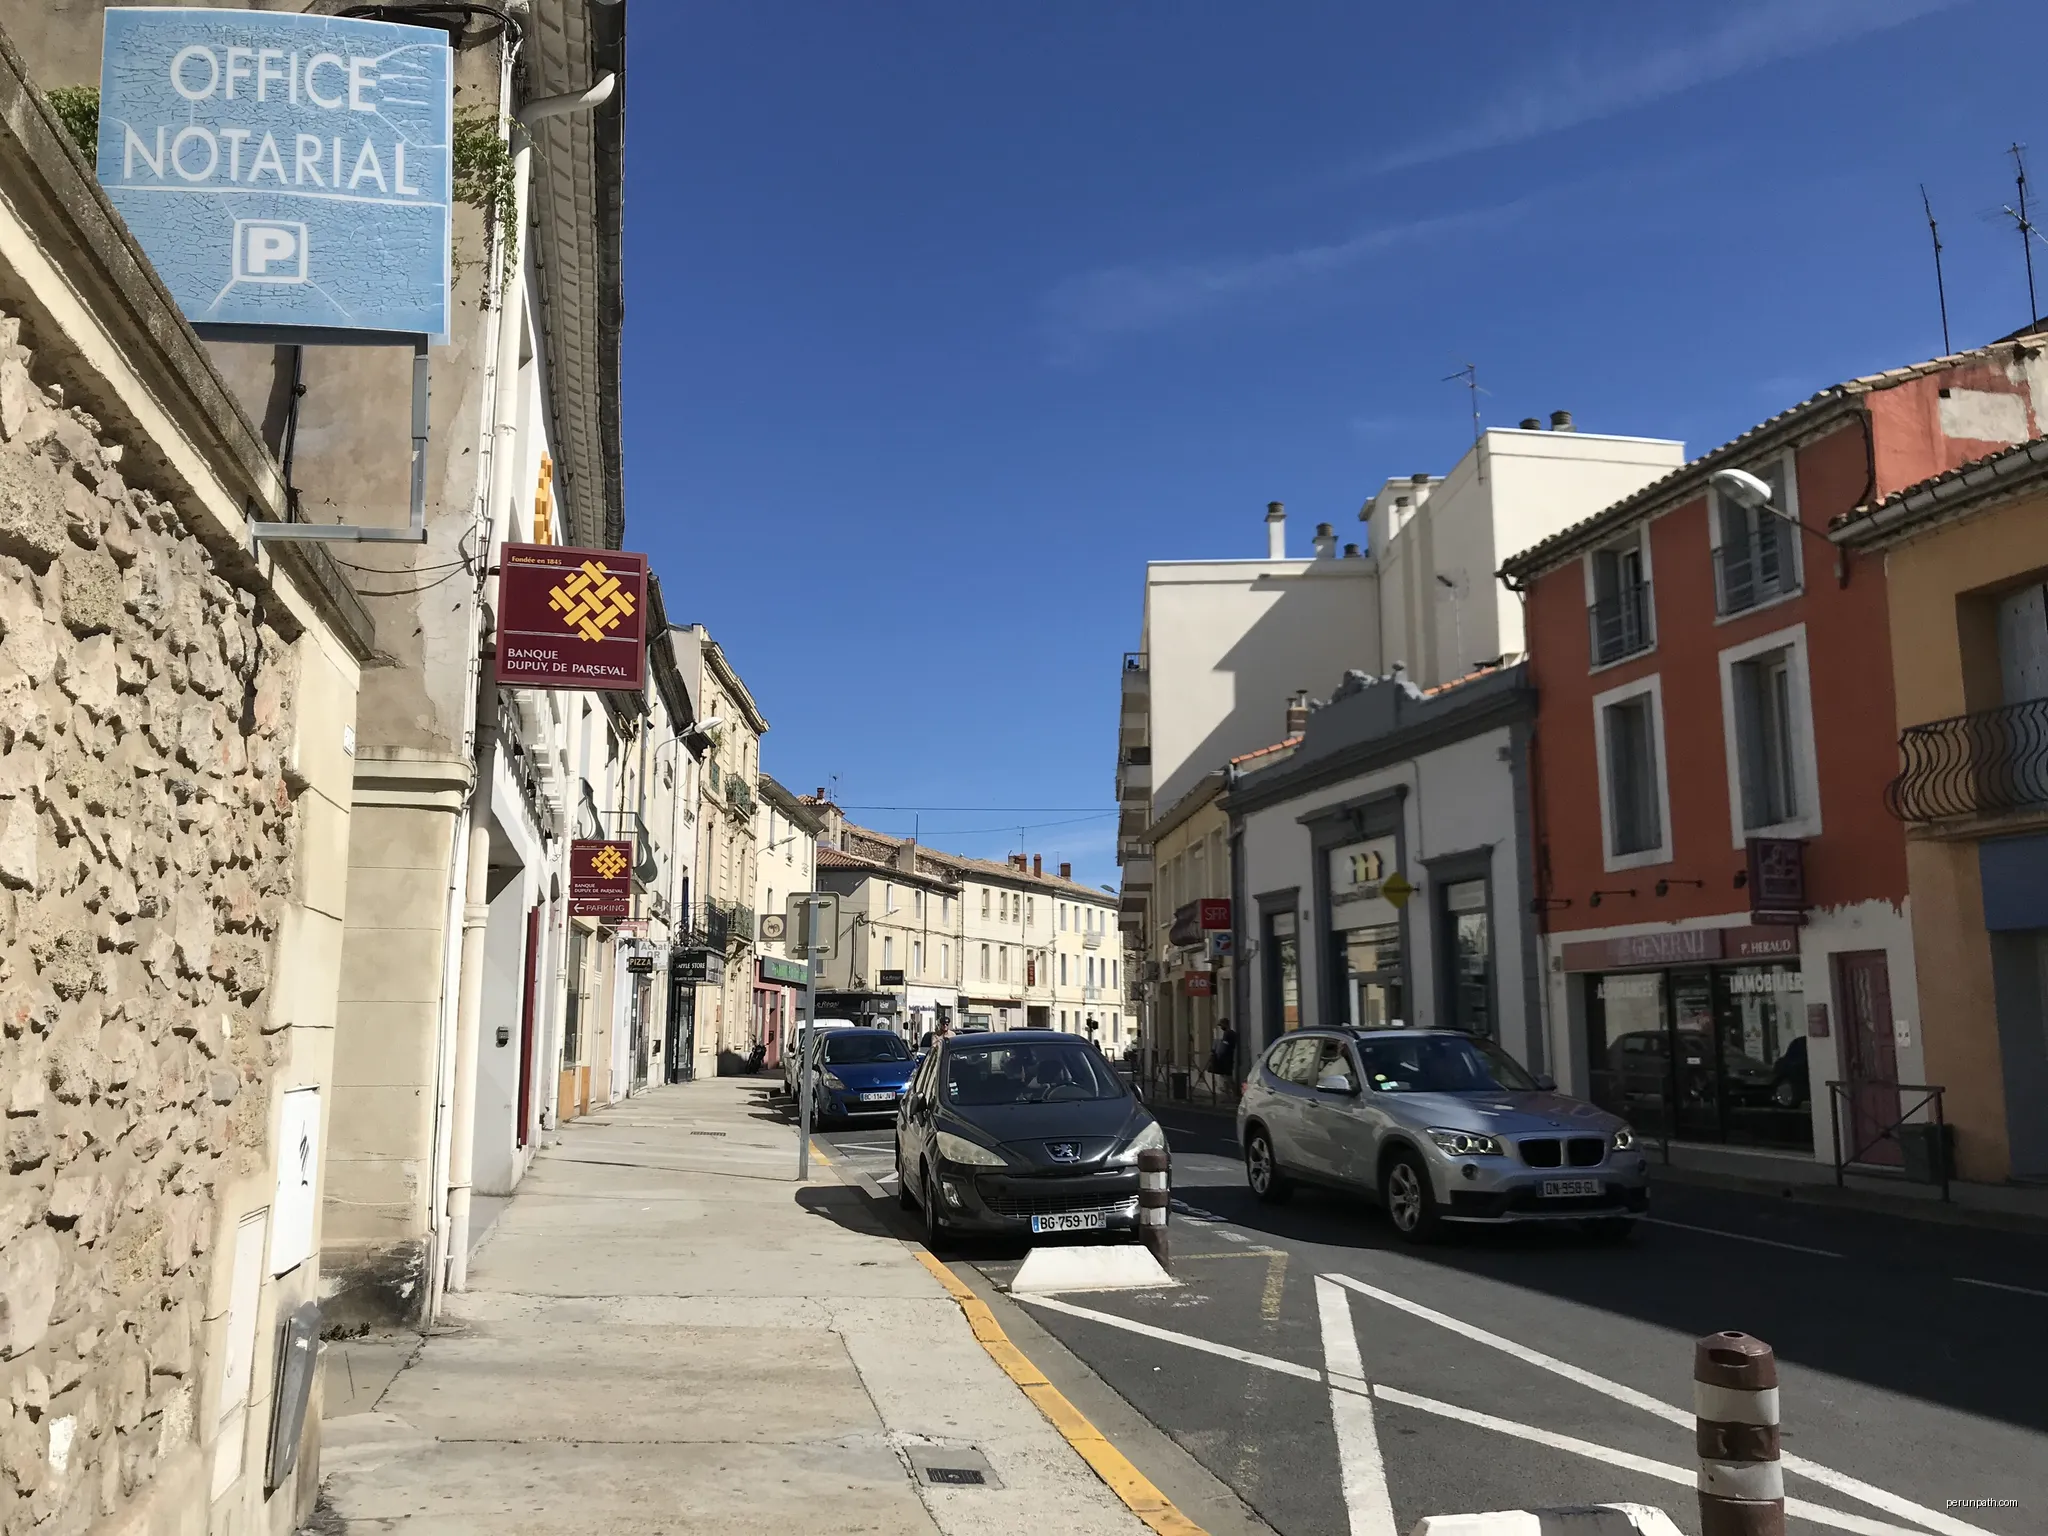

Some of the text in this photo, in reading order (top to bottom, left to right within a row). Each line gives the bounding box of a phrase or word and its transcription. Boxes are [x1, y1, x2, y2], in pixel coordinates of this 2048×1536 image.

[169, 45, 377, 112] OFFICE
[123, 124, 420, 195] NOTARIAL
[247, 227, 296, 273] P
[511, 555, 536, 564] Fondée
[507, 648, 559, 660] BANQUE
[507, 660, 628, 676] DUPUY, DE PARSEVAL
[585, 904, 626, 912] PARKING
[1204, 907, 1228, 920] SFR
[640, 942, 667, 951] Achat
[1632, 930, 1705, 957] GENERALI
[646, 950, 661, 959] OR
[629, 958, 652, 966] PIZZA
[1188, 975, 1209, 988] ria
[1040, 1215, 1098, 1230] BG-759-YD
